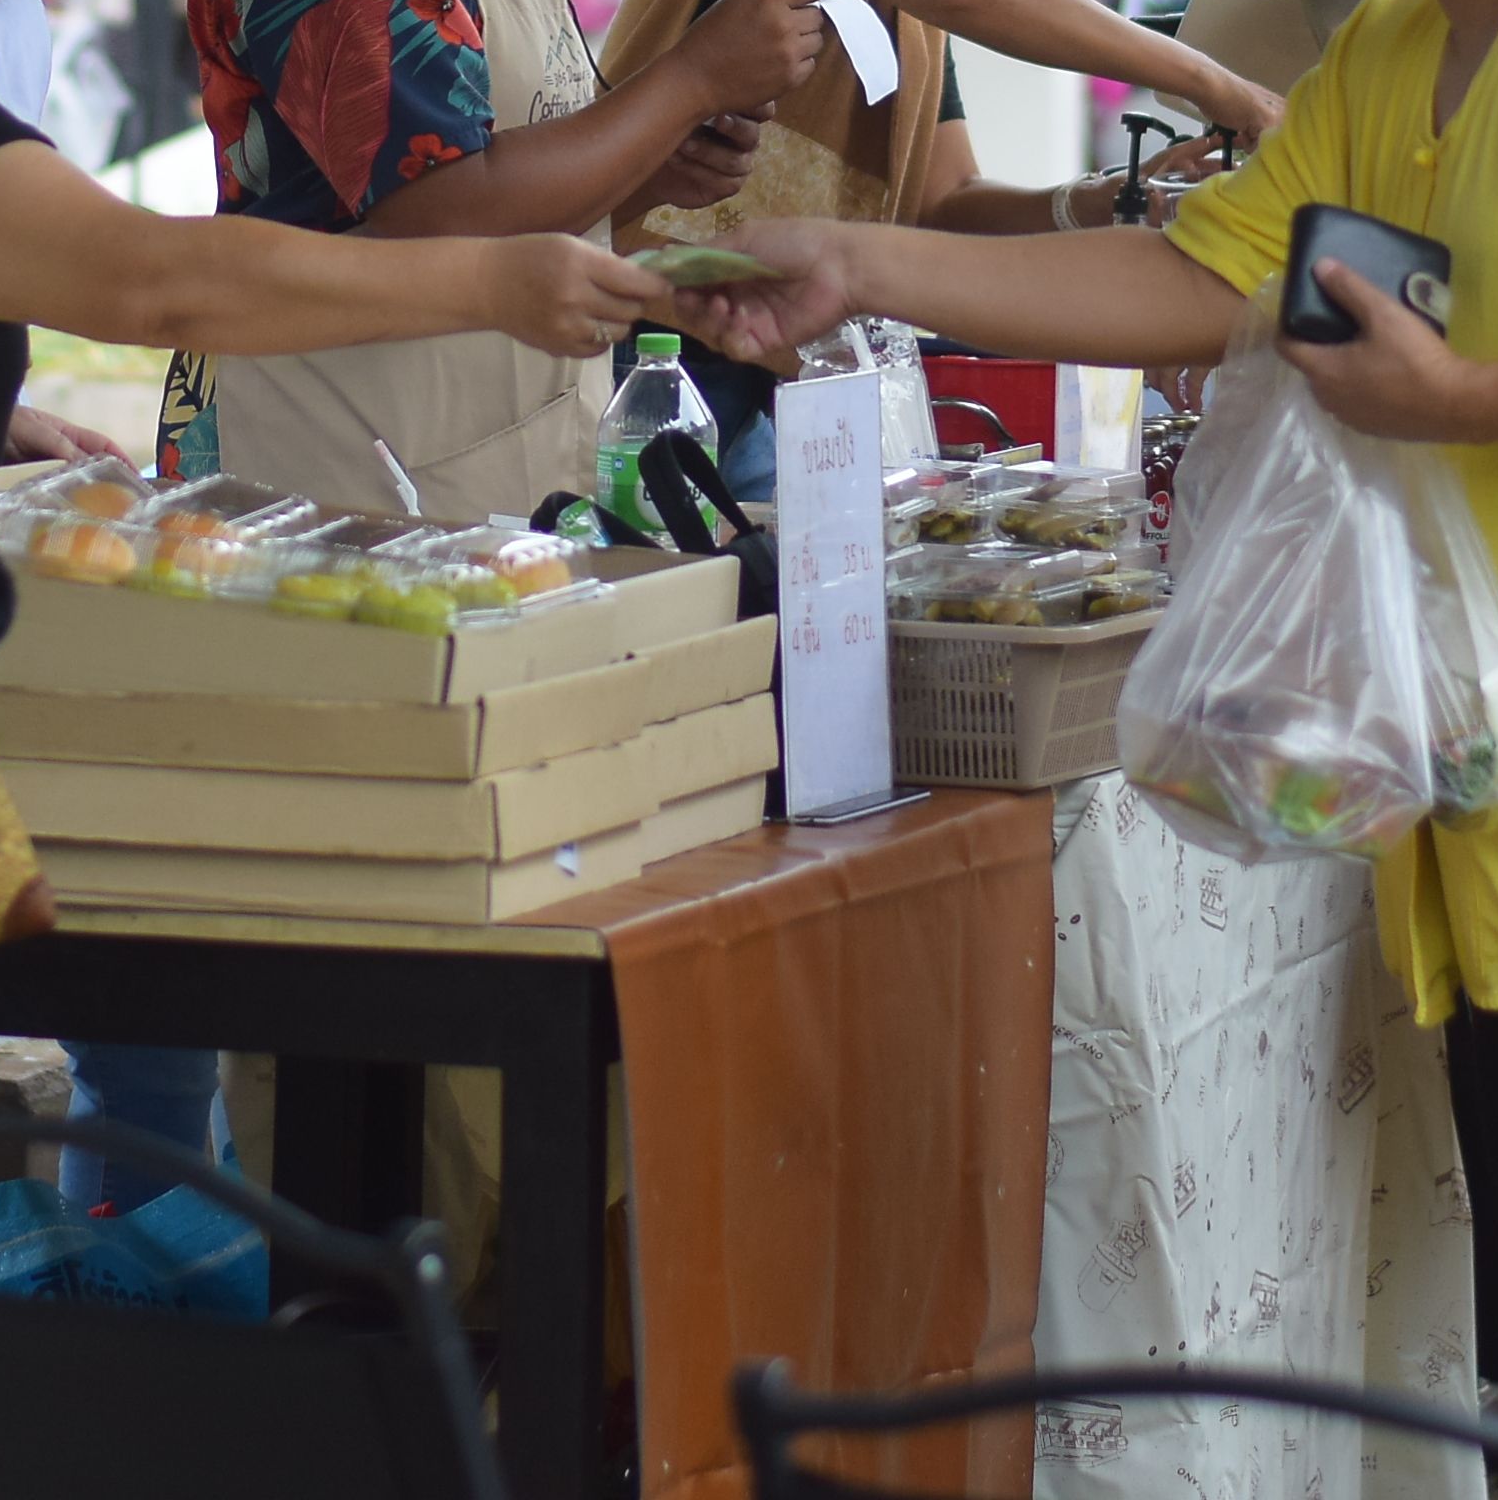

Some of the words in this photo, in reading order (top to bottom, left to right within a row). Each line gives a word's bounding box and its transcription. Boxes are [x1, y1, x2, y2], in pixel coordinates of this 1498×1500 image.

[529, 90, 572, 124] Coffee
[802, 417, 855, 474] ขนมปัง
[791, 555, 799, 585] 2
[843, 543, 857, 575] 35
[792, 626, 800, 655] 4
[844, 613, 859, 645] 60
